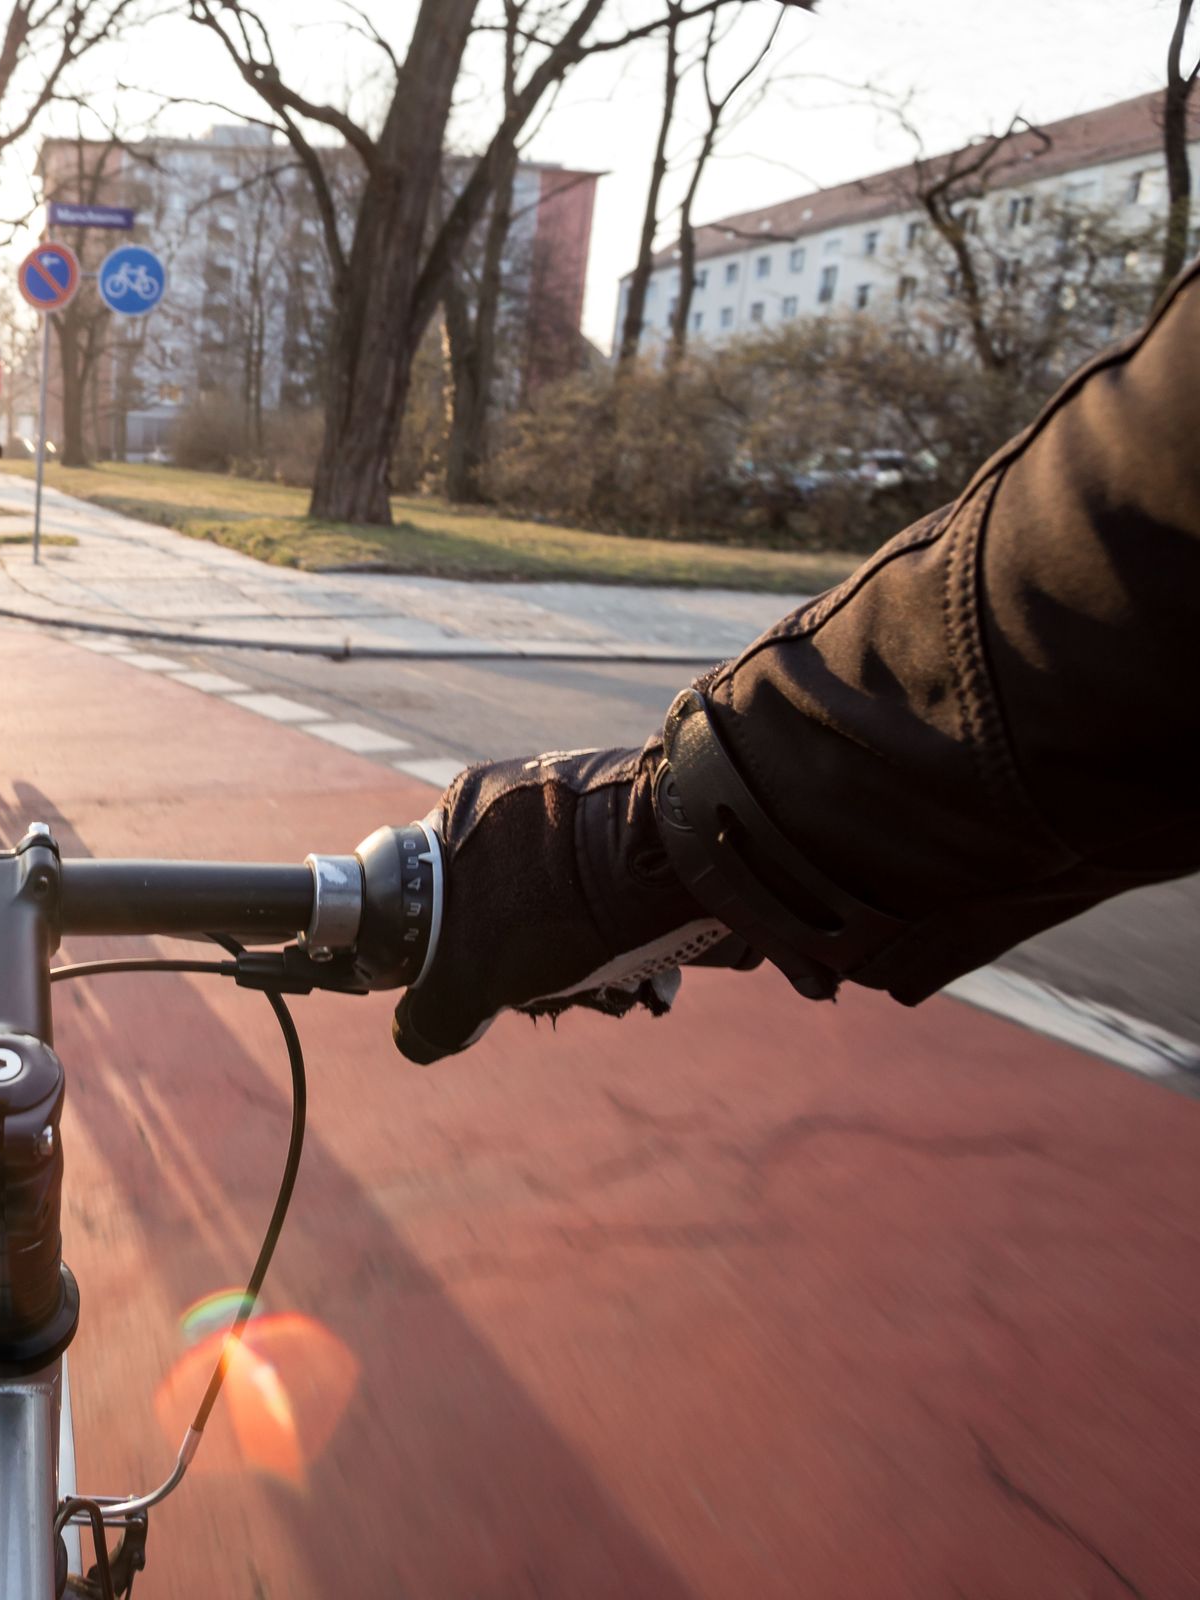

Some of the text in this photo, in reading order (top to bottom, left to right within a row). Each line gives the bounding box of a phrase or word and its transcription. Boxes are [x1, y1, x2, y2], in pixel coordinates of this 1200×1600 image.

[406, 856, 419, 869] 5
[407, 877, 421, 891] 4
[406, 902, 421, 917] 3
[404, 927, 419, 942] 2
